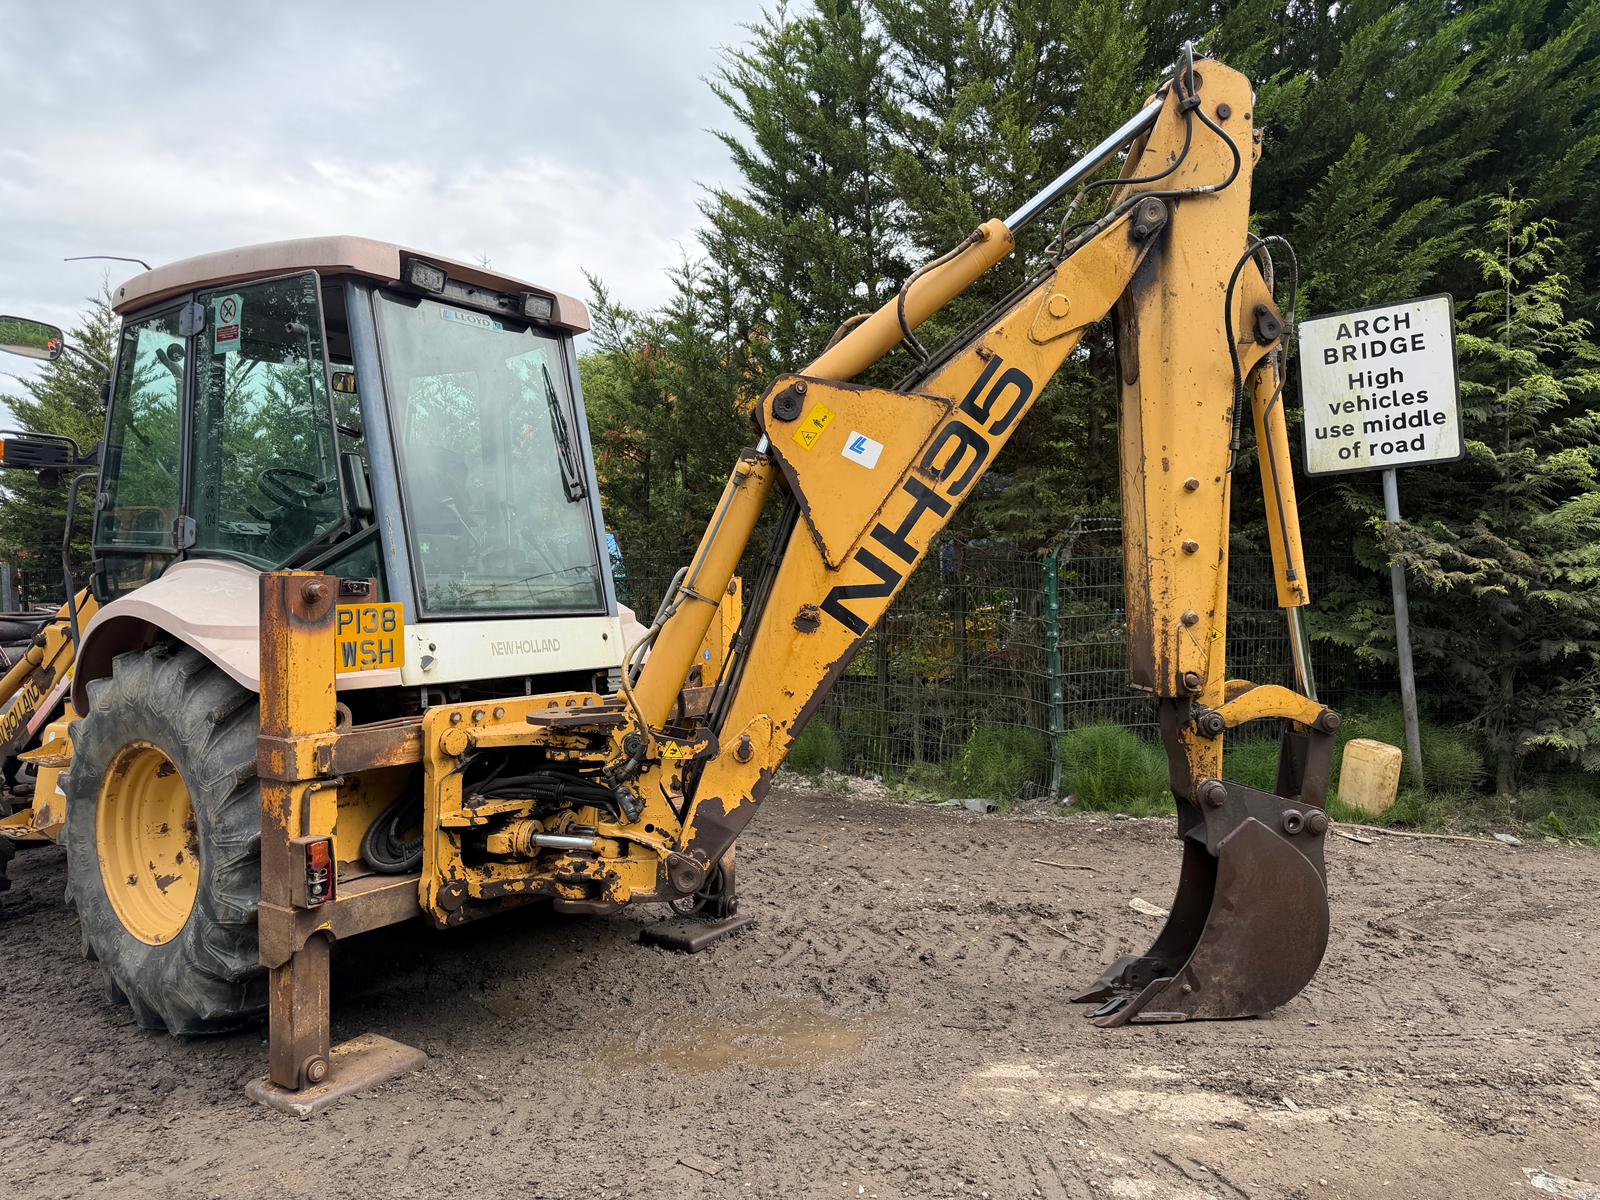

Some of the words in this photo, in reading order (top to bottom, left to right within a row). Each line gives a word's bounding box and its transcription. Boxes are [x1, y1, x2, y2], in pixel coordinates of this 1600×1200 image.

[454, 311, 491, 327] LLOYD
[1336, 312, 1410, 341] ARCH
[1323, 333, 1426, 365] BRIDGE
[1348, 367, 1404, 390] High
[1328, 389, 1429, 415] vehicles
[1315, 423, 1355, 440] use
[1363, 409, 1447, 434] middle
[1338, 441, 1361, 460] of
[1369, 433, 1425, 456] road
[820, 354, 1034, 637] NH95
[337, 607, 397, 635] P138
[341, 638, 394, 667] WSH
[491, 640, 514, 656] NEW
[515, 638, 561, 654] HOLLAND
